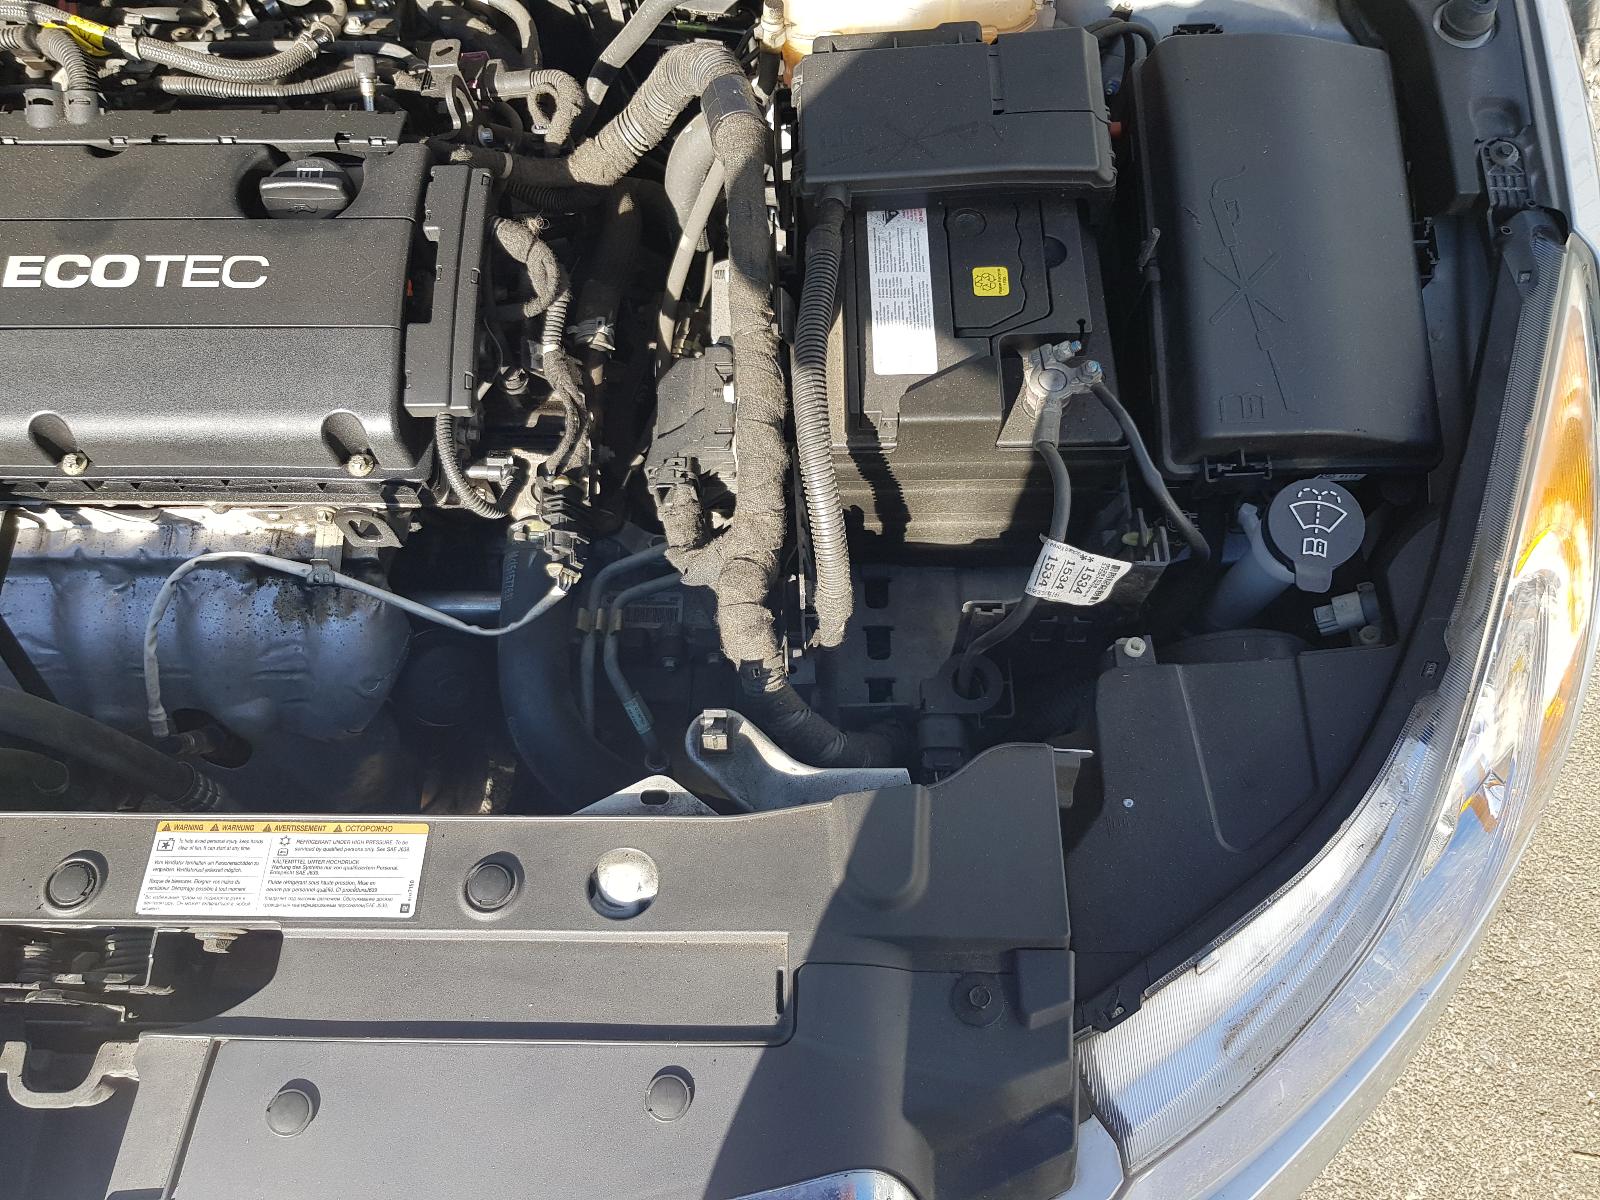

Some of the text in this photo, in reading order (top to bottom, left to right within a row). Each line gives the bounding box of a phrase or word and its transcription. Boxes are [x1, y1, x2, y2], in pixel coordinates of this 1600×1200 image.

[2, 254, 270, 289] ECOTEC
[1039, 555, 1058, 587] 1534
[1055, 560, 1076, 590] 1534
[1072, 566, 1095, 595] 1534
